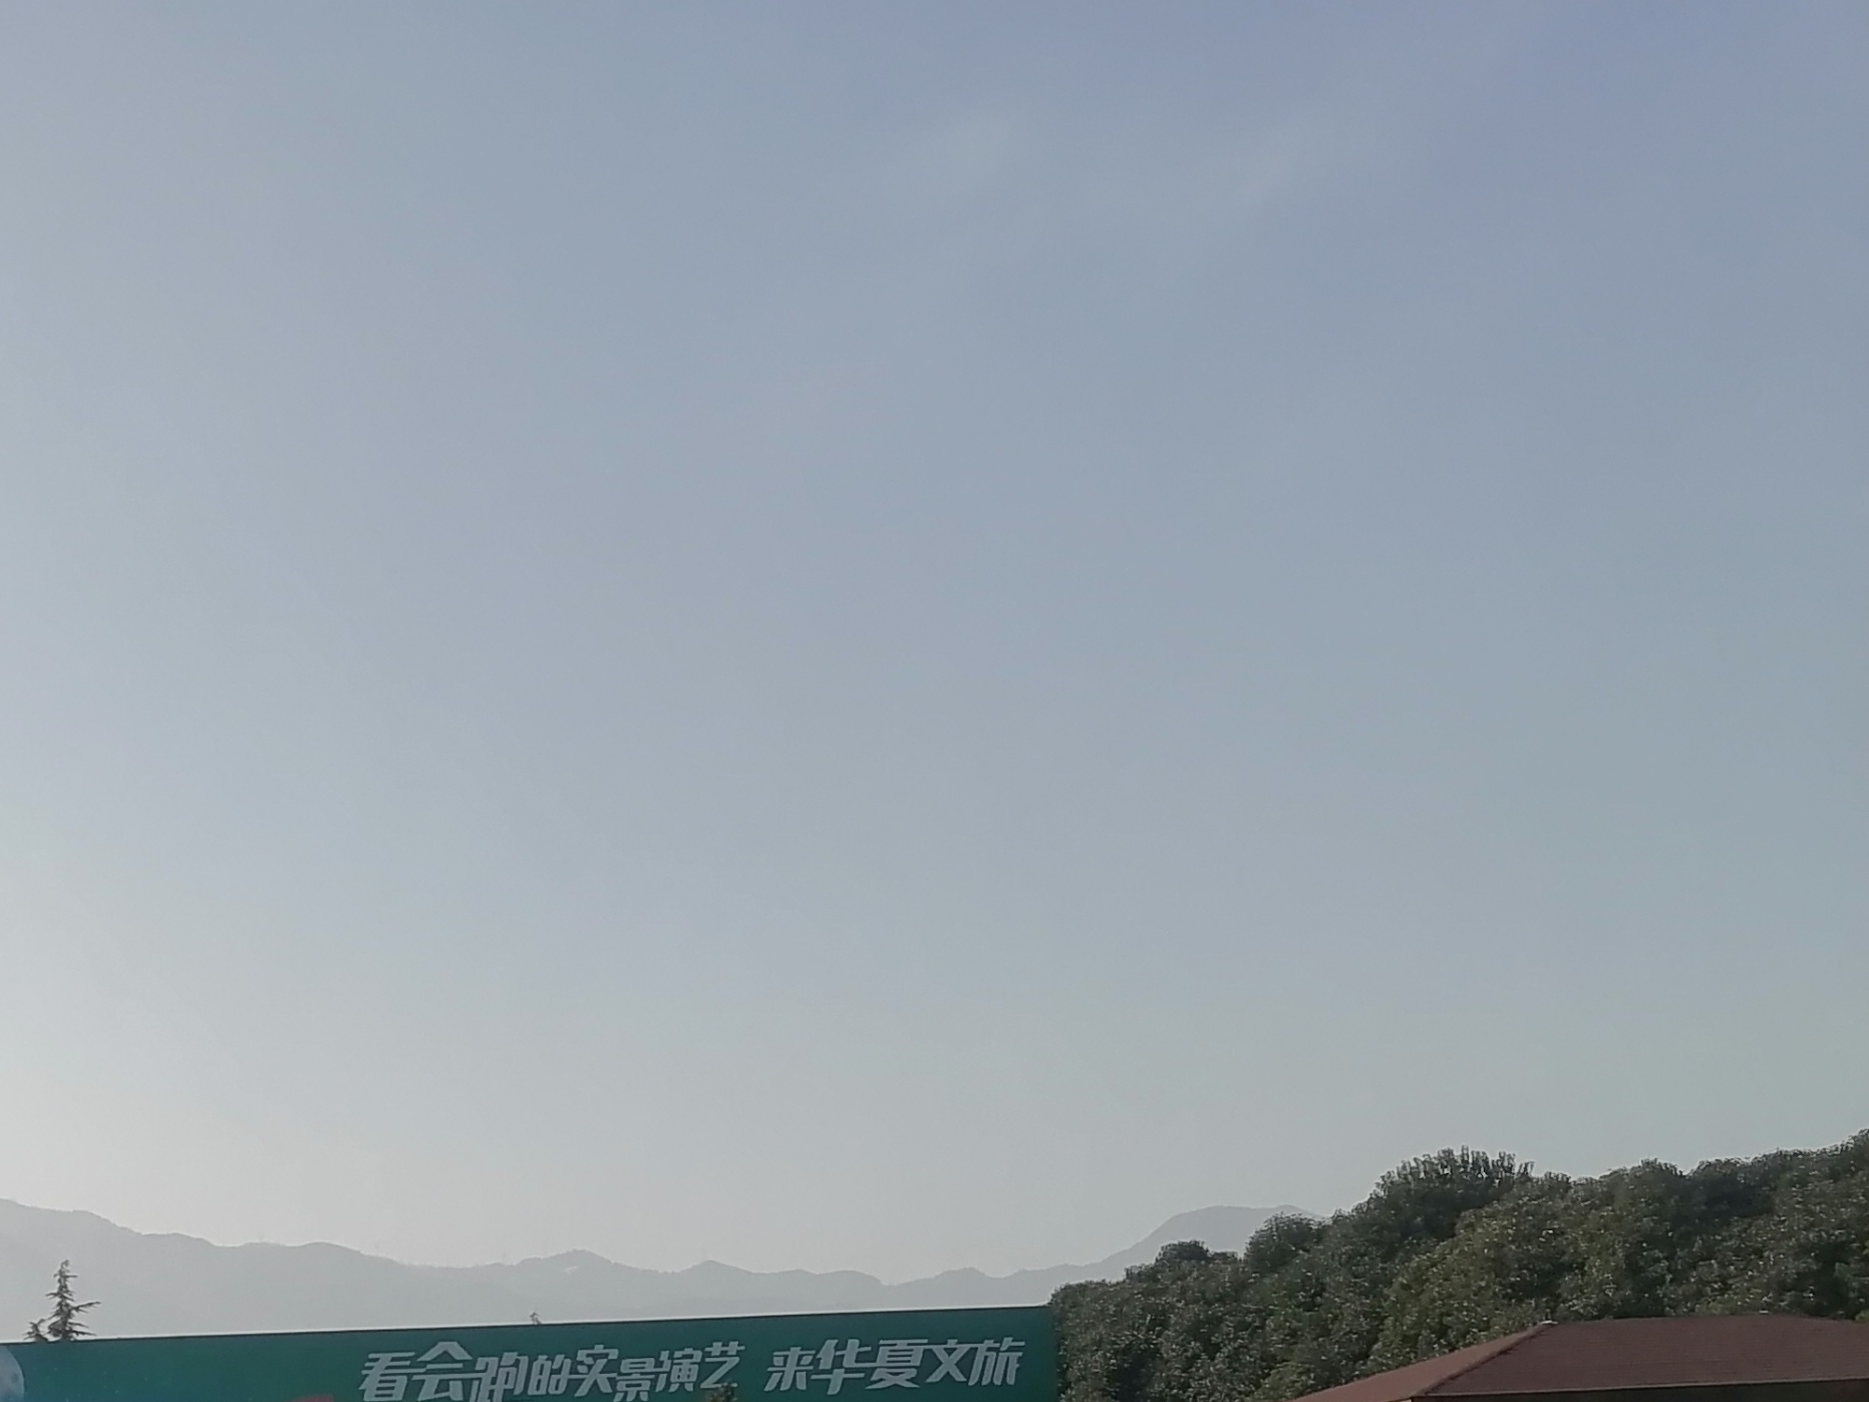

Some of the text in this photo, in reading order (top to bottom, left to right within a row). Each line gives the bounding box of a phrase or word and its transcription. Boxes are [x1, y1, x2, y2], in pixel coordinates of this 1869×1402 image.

[764, 1337, 1026, 1395] 来华夏文旅
